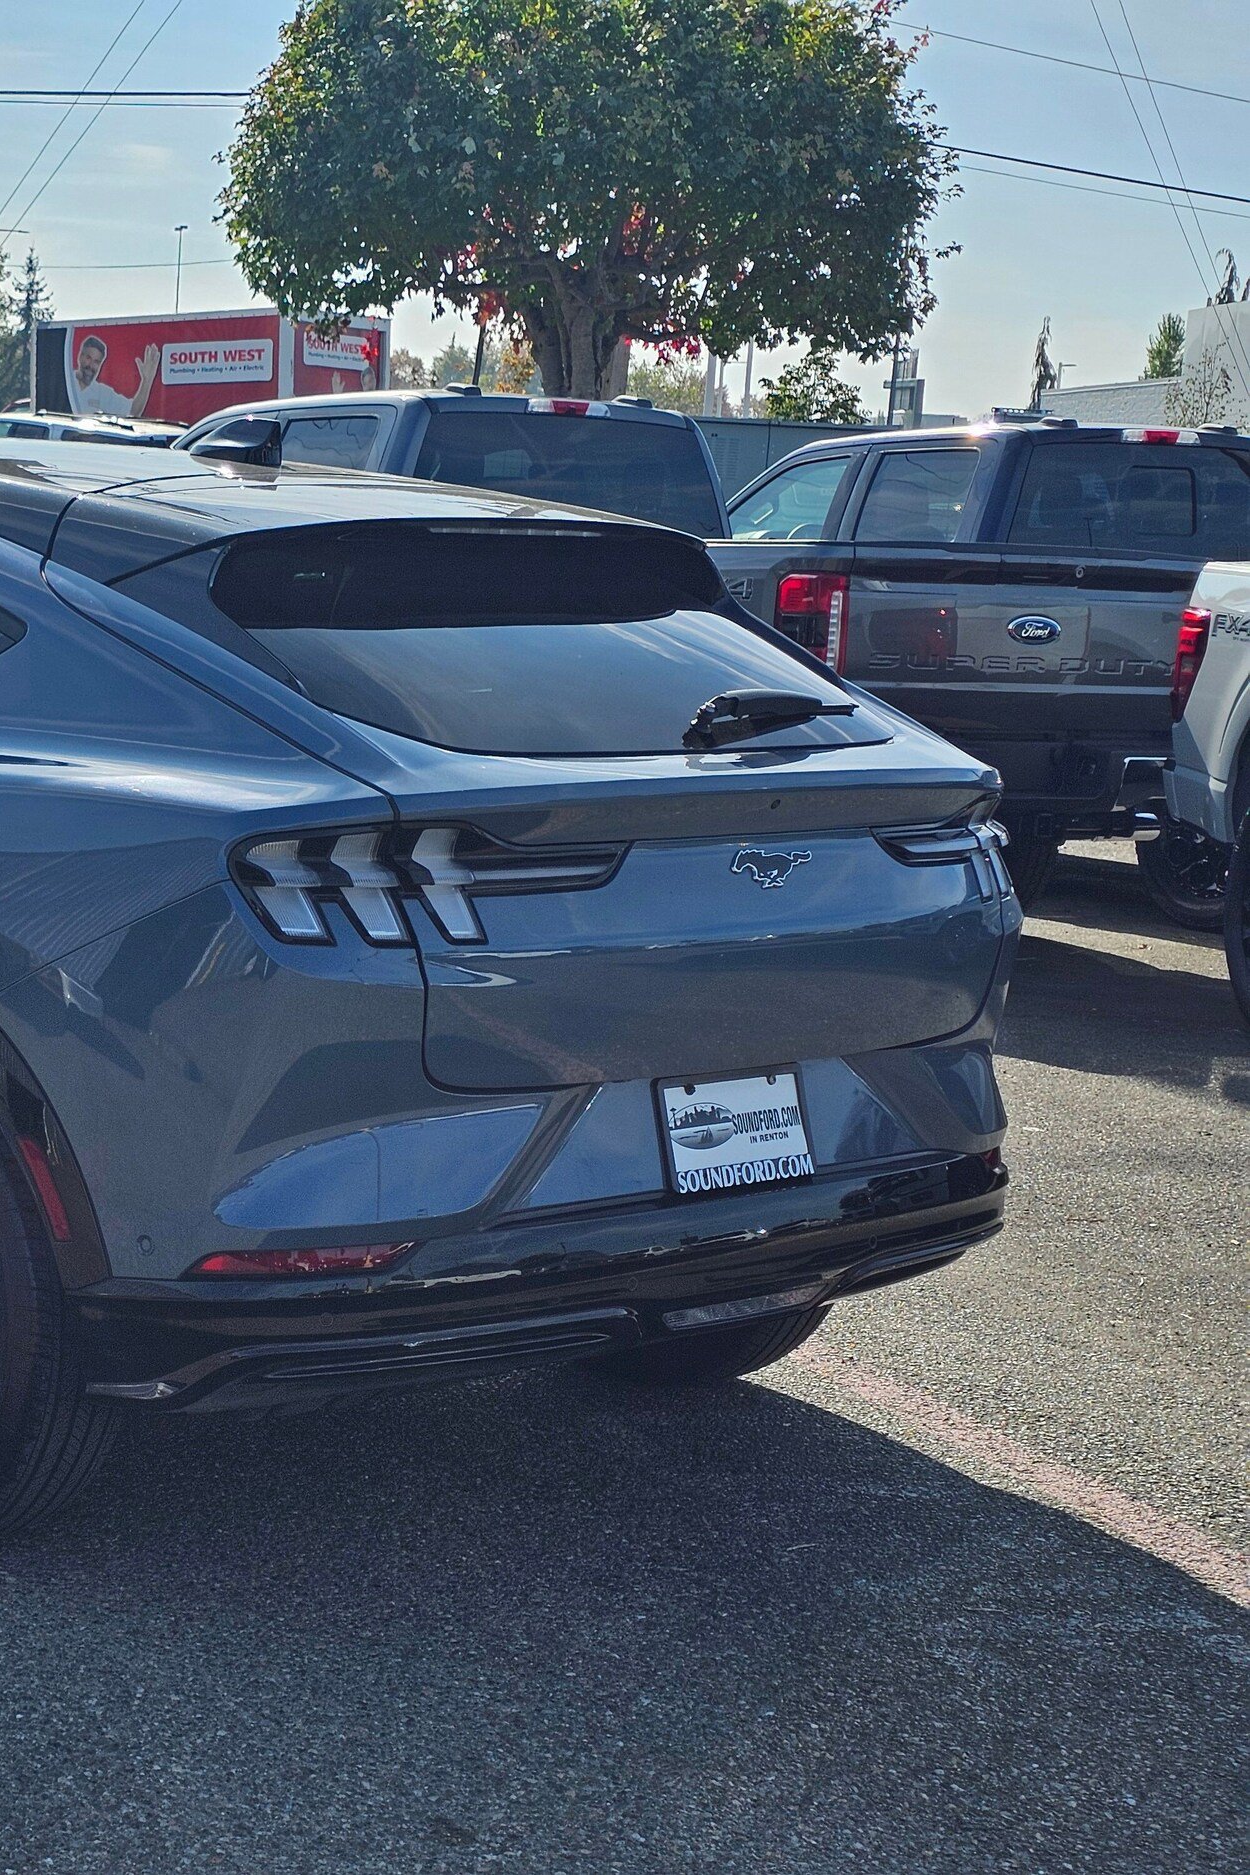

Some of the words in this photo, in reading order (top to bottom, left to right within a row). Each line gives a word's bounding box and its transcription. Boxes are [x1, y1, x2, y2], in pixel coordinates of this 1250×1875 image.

[169, 350, 218, 365] SOUTH
[223, 348, 265, 363] WEST
[340, 342, 364, 355] WES
[169, 366, 196, 375] Plumbing
[201, 365, 224, 374] Heating
[243, 364, 264, 372] Electric
[1021, 621, 1051, 639] Ford
[868, 652, 1047, 675] SUPER
[1058, 656, 1177, 678] DUTY
[732, 1105, 801, 1136] SOUNDFORD.COM
[749, 1135, 758, 1144] IN
[759, 1131, 789, 1143] RENTON
[677, 1153, 815, 1194] SOUNDFORD.COM
